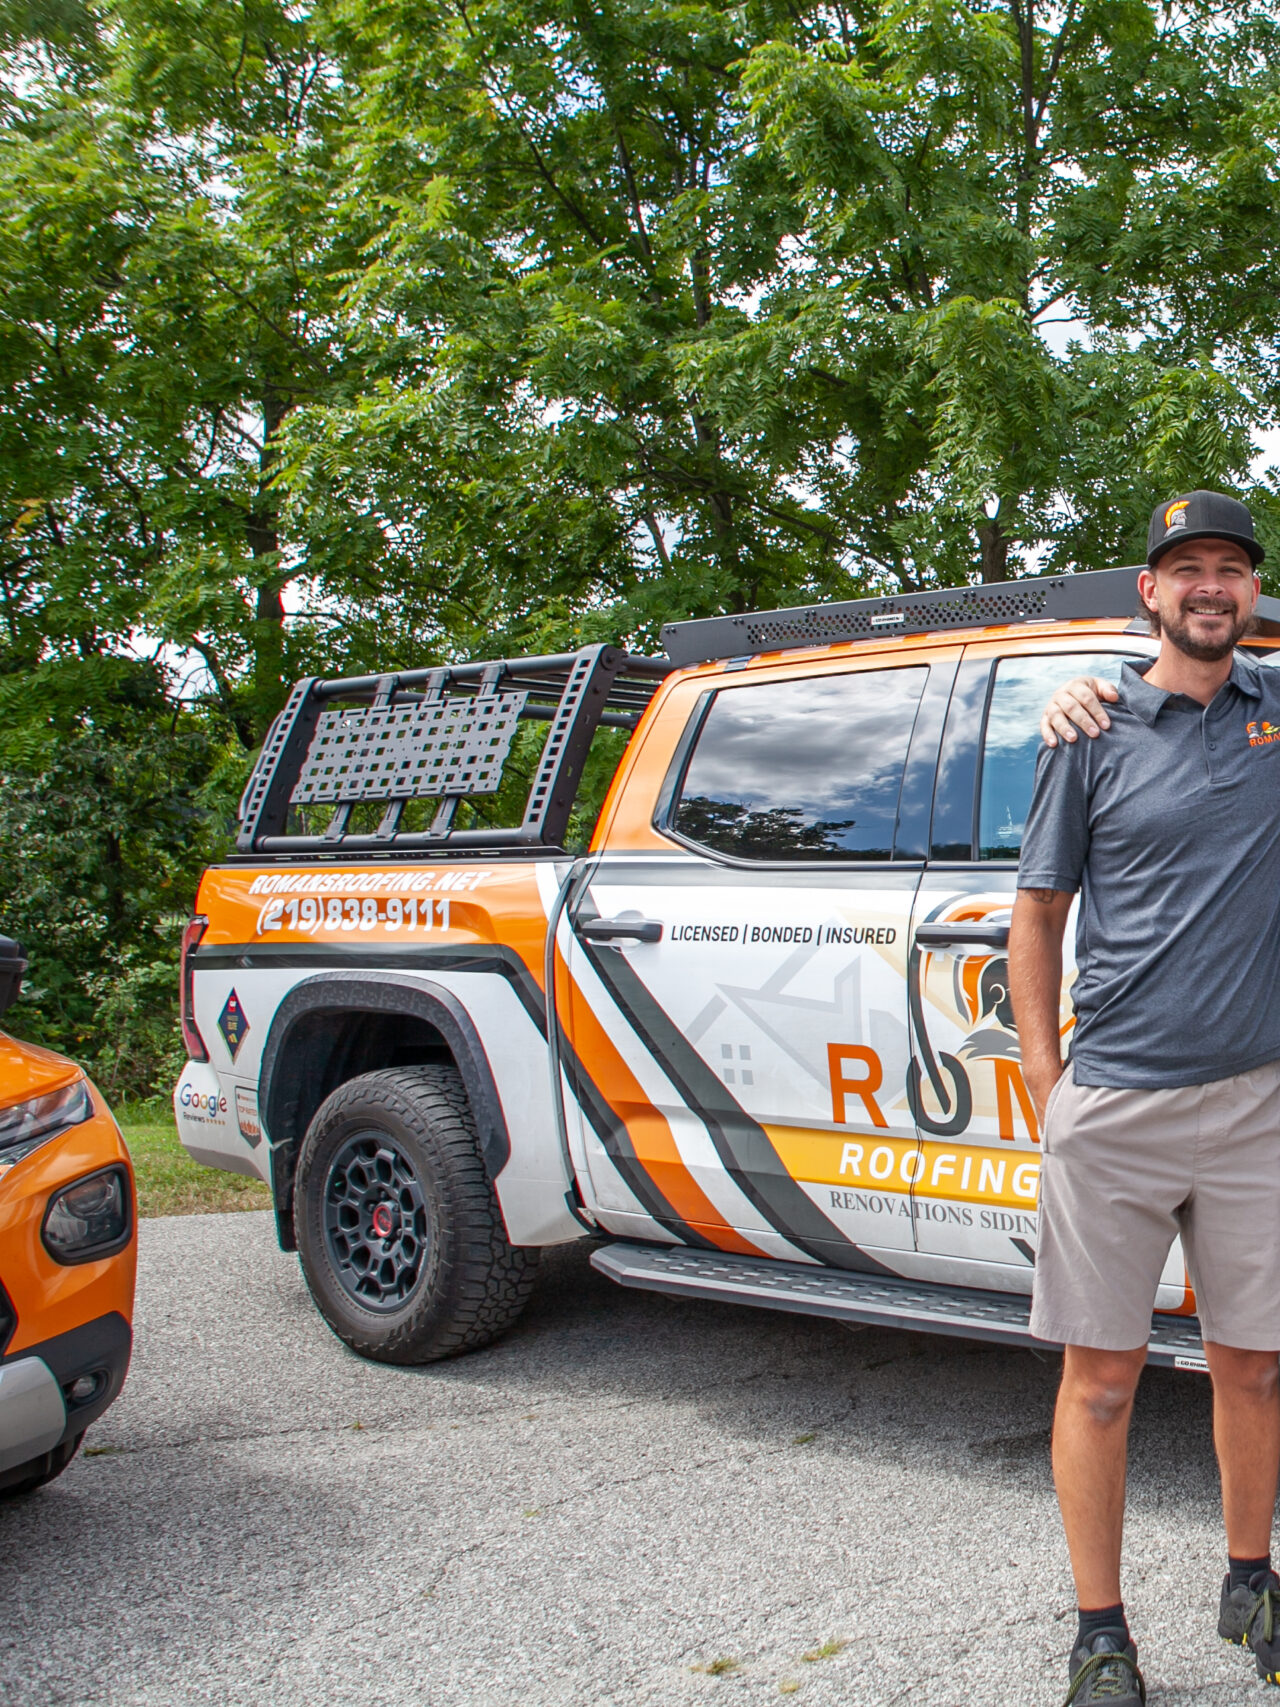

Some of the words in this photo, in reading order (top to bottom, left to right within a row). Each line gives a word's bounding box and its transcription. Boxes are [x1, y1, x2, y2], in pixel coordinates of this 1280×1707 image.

[248, 871, 492, 895] ROMANSROOFING.NET
[256, 896, 451, 935] (219)838-9111
[671, 925, 739, 942] LICENSED
[751, 926, 813, 943] BONDED
[826, 928, 896, 945] INSURED
[181, 1083, 227, 1117] Google
[183, 1111, 205, 1123] Reviews
[839, 1142, 1041, 1198] ROOFING
[829, 1191, 974, 1227] RENOVATIONS
